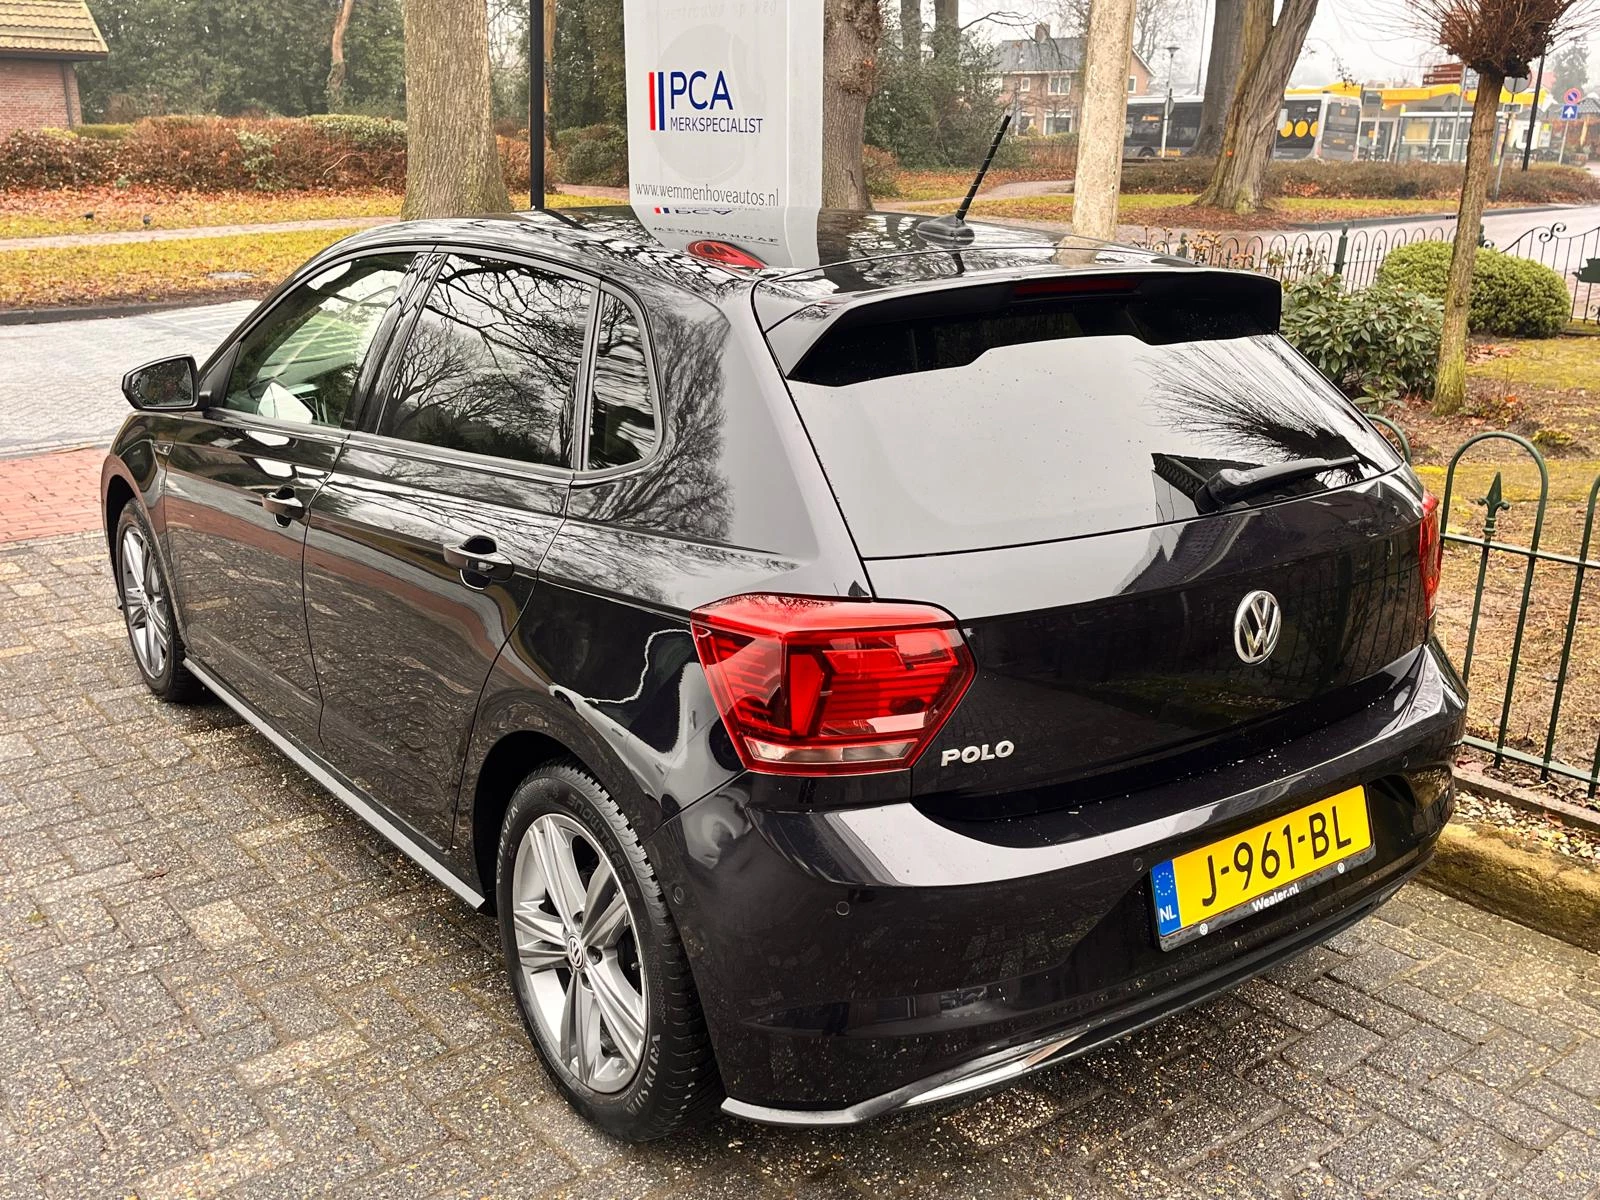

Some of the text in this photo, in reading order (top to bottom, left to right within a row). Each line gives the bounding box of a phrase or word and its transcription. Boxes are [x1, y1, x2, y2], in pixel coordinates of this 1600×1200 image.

[670, 70, 733, 111] PCA
[670, 117, 763, 134] MERKSPECIALIST
[635, 183, 779, 207] www.wemmenhoveautos.nl
[940, 740, 1015, 767] POLO
[1202, 805, 1352, 908] J-961-BL
[1251, 883, 1300, 912] Wealer.nl
[1159, 905, 1177, 923] NL
